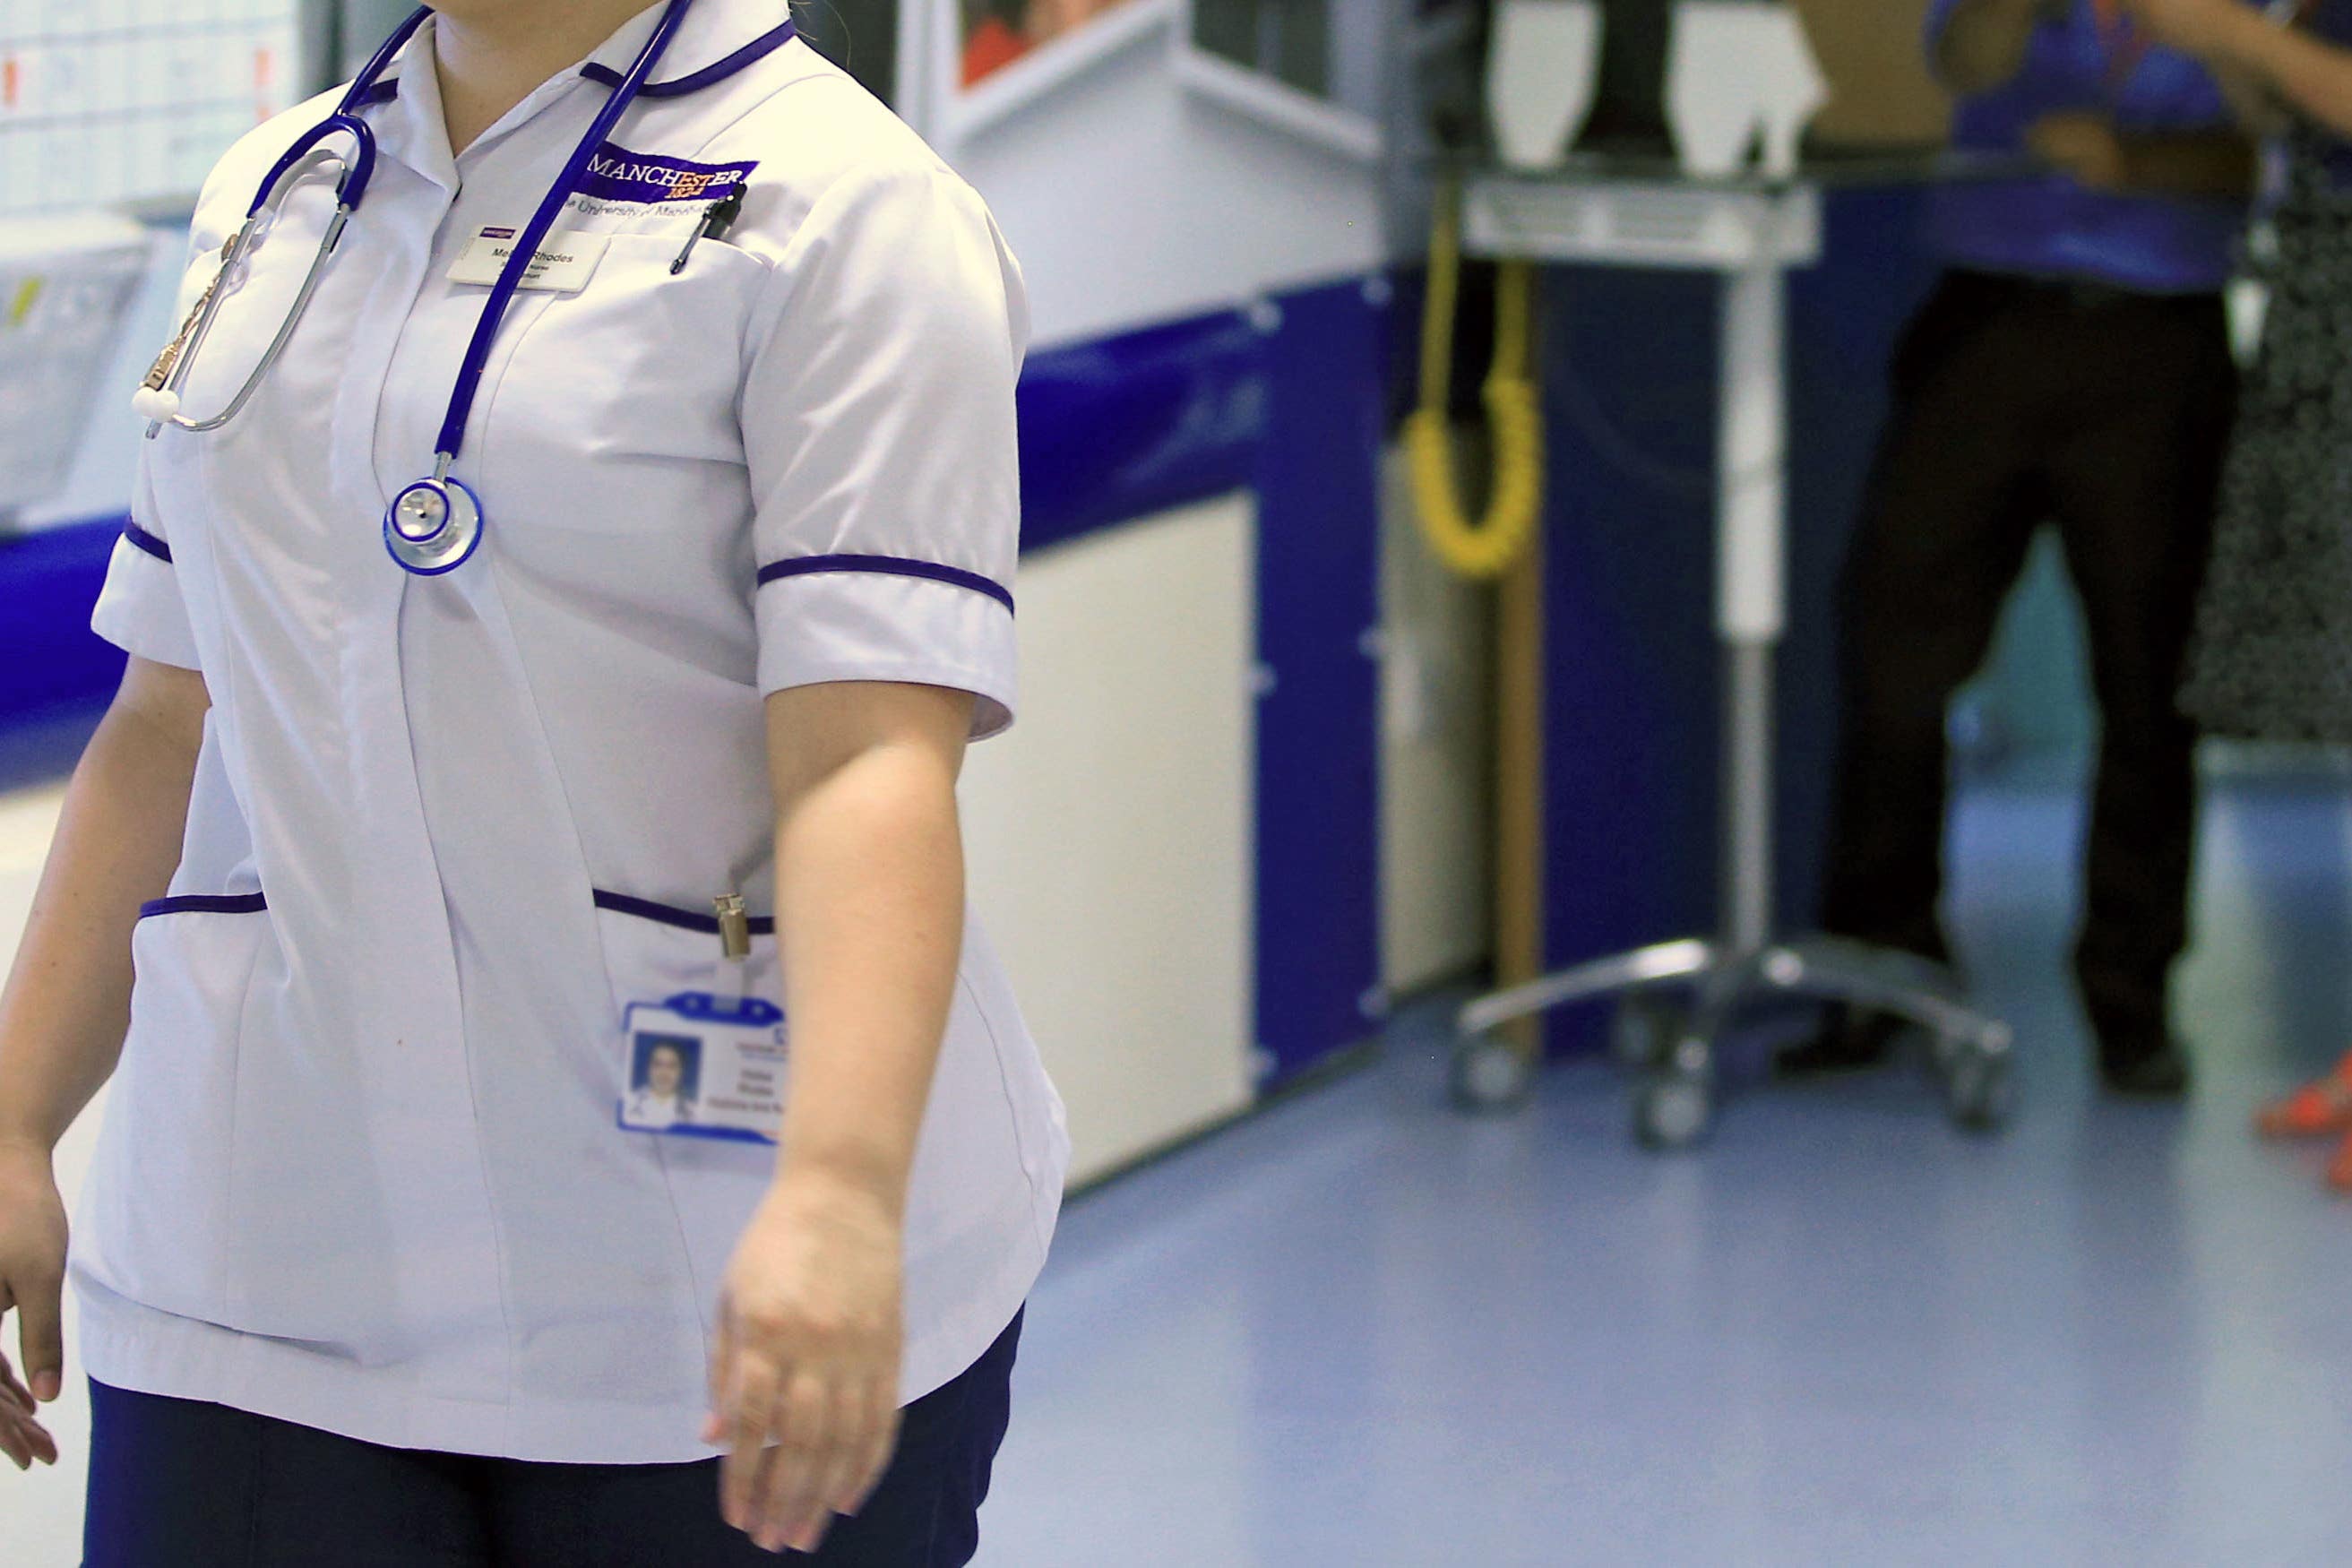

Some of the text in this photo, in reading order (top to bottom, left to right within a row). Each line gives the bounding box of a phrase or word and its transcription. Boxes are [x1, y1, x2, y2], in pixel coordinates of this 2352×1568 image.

[586, 153, 745, 187] MANCHESTER
[664, 186, 705, 199] 1824
[533, 251, 574, 263] Rhodes
